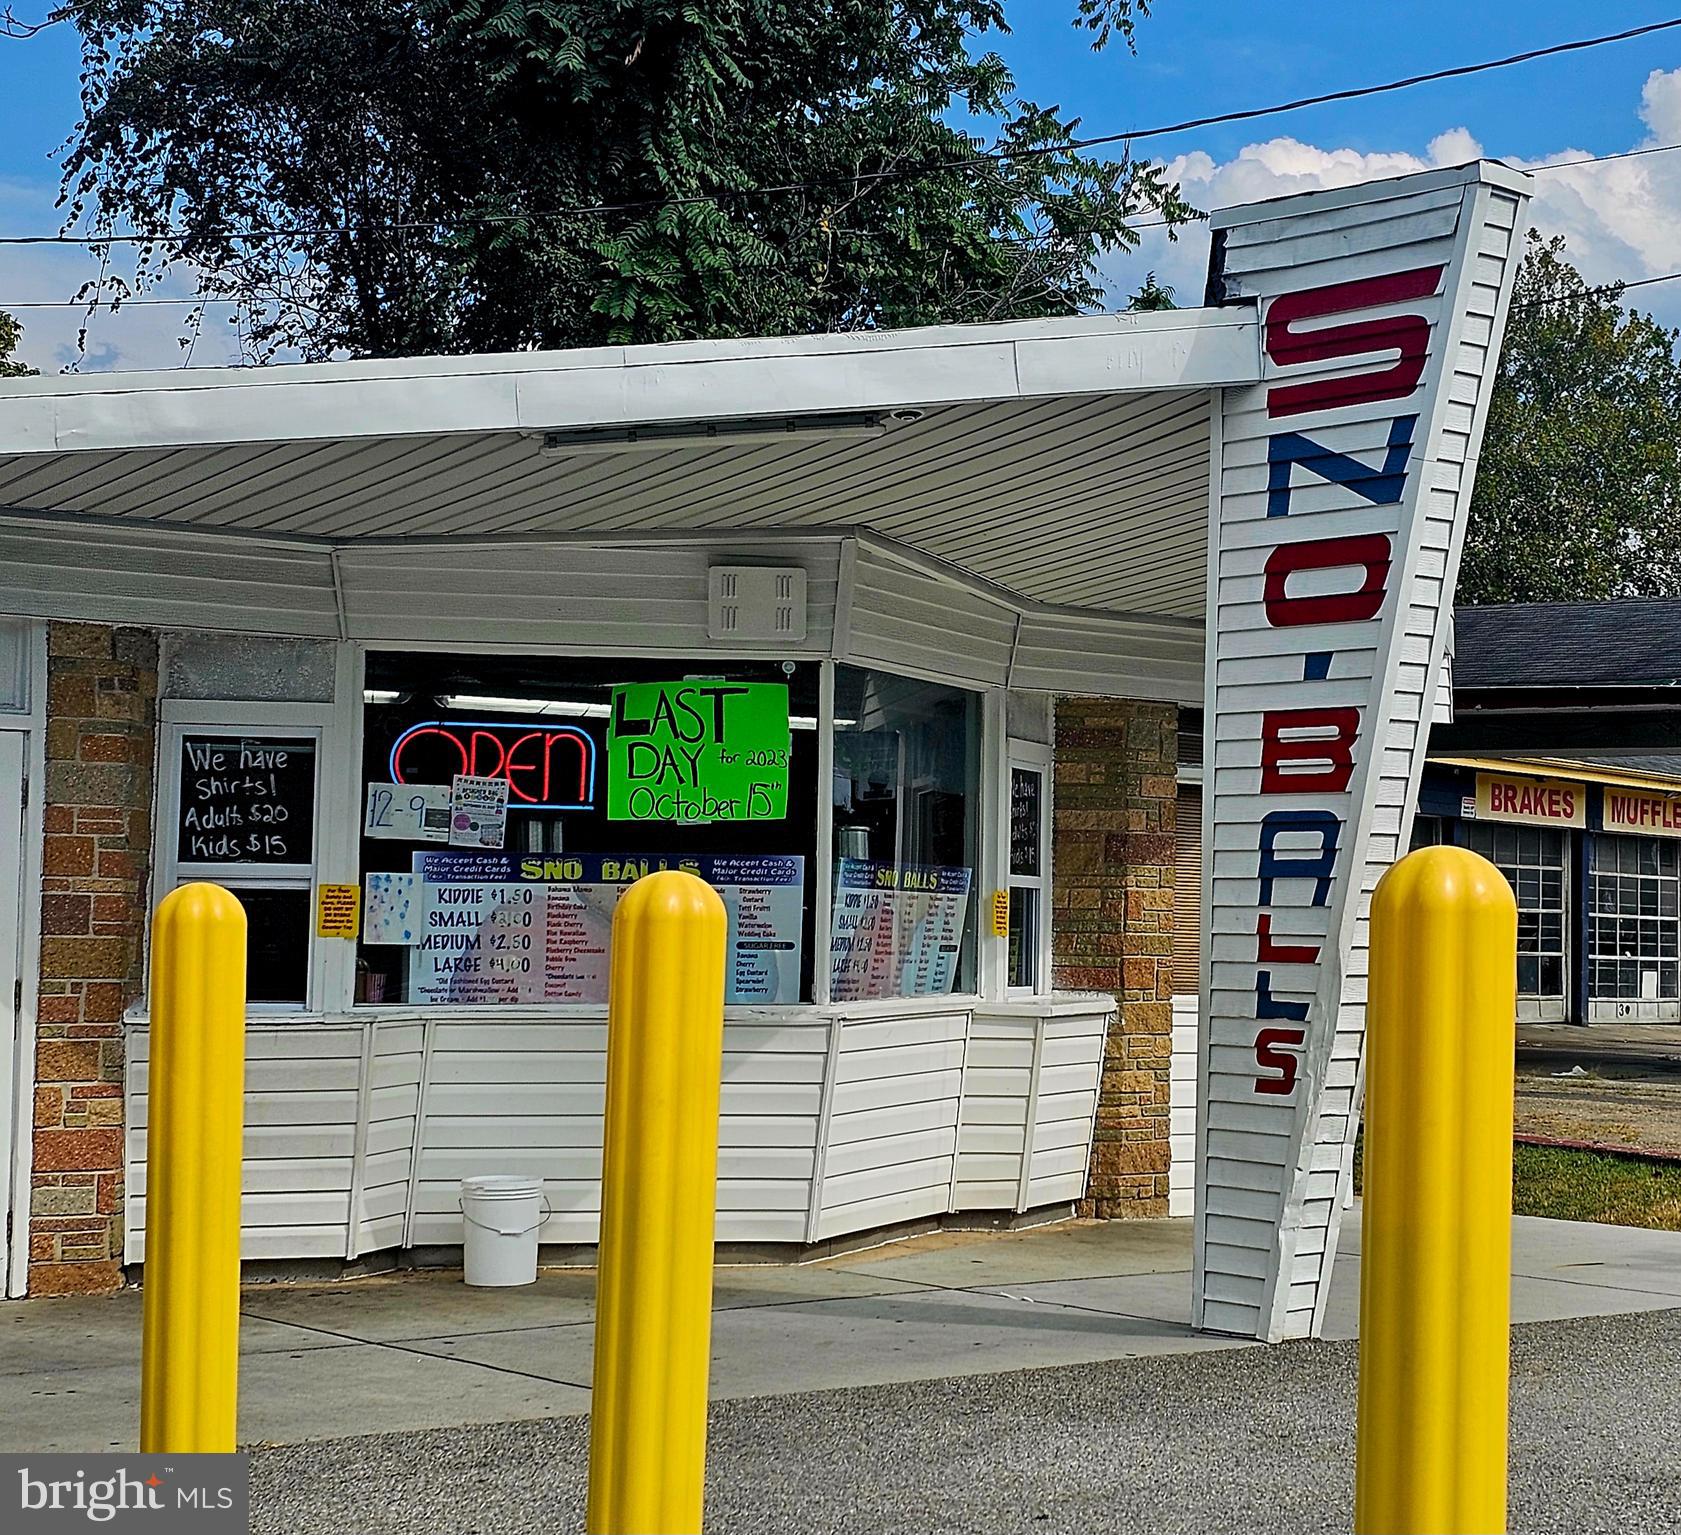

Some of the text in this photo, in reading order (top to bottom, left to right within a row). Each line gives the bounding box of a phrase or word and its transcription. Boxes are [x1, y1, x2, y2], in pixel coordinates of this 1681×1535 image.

[614, 687, 750, 744] LAST
[185, 740, 288, 771] We have
[394, 728, 587, 802] OPEN
[627, 742, 788, 788] DAY for 2023
[195, 773, 277, 800] Shirts!
[629, 786, 741, 820] October
[1490, 783, 1575, 819] BRAKES
[1611, 795, 1681, 829] MUFFLE
[185, 804, 289, 831] Adults $20
[191, 833, 288, 857] Kids $15
[425, 857, 439, 865] We
[453, 865, 482, 873] Credit
[485, 865, 511, 873] Cards
[520, 858, 583, 880] SNO
[761, 859, 783, 867] Cash
[785, 859, 794, 867] &
[770, 868, 796, 876] Cards
[904, 871, 938, 889] BALLS
[437, 888, 533, 905] KIDDIE $1.50
[429, 911, 483, 927] SMALL
[416, 934, 532, 950] MEDIUM $2.50
[434, 957, 531, 973] LARGE $4.00
